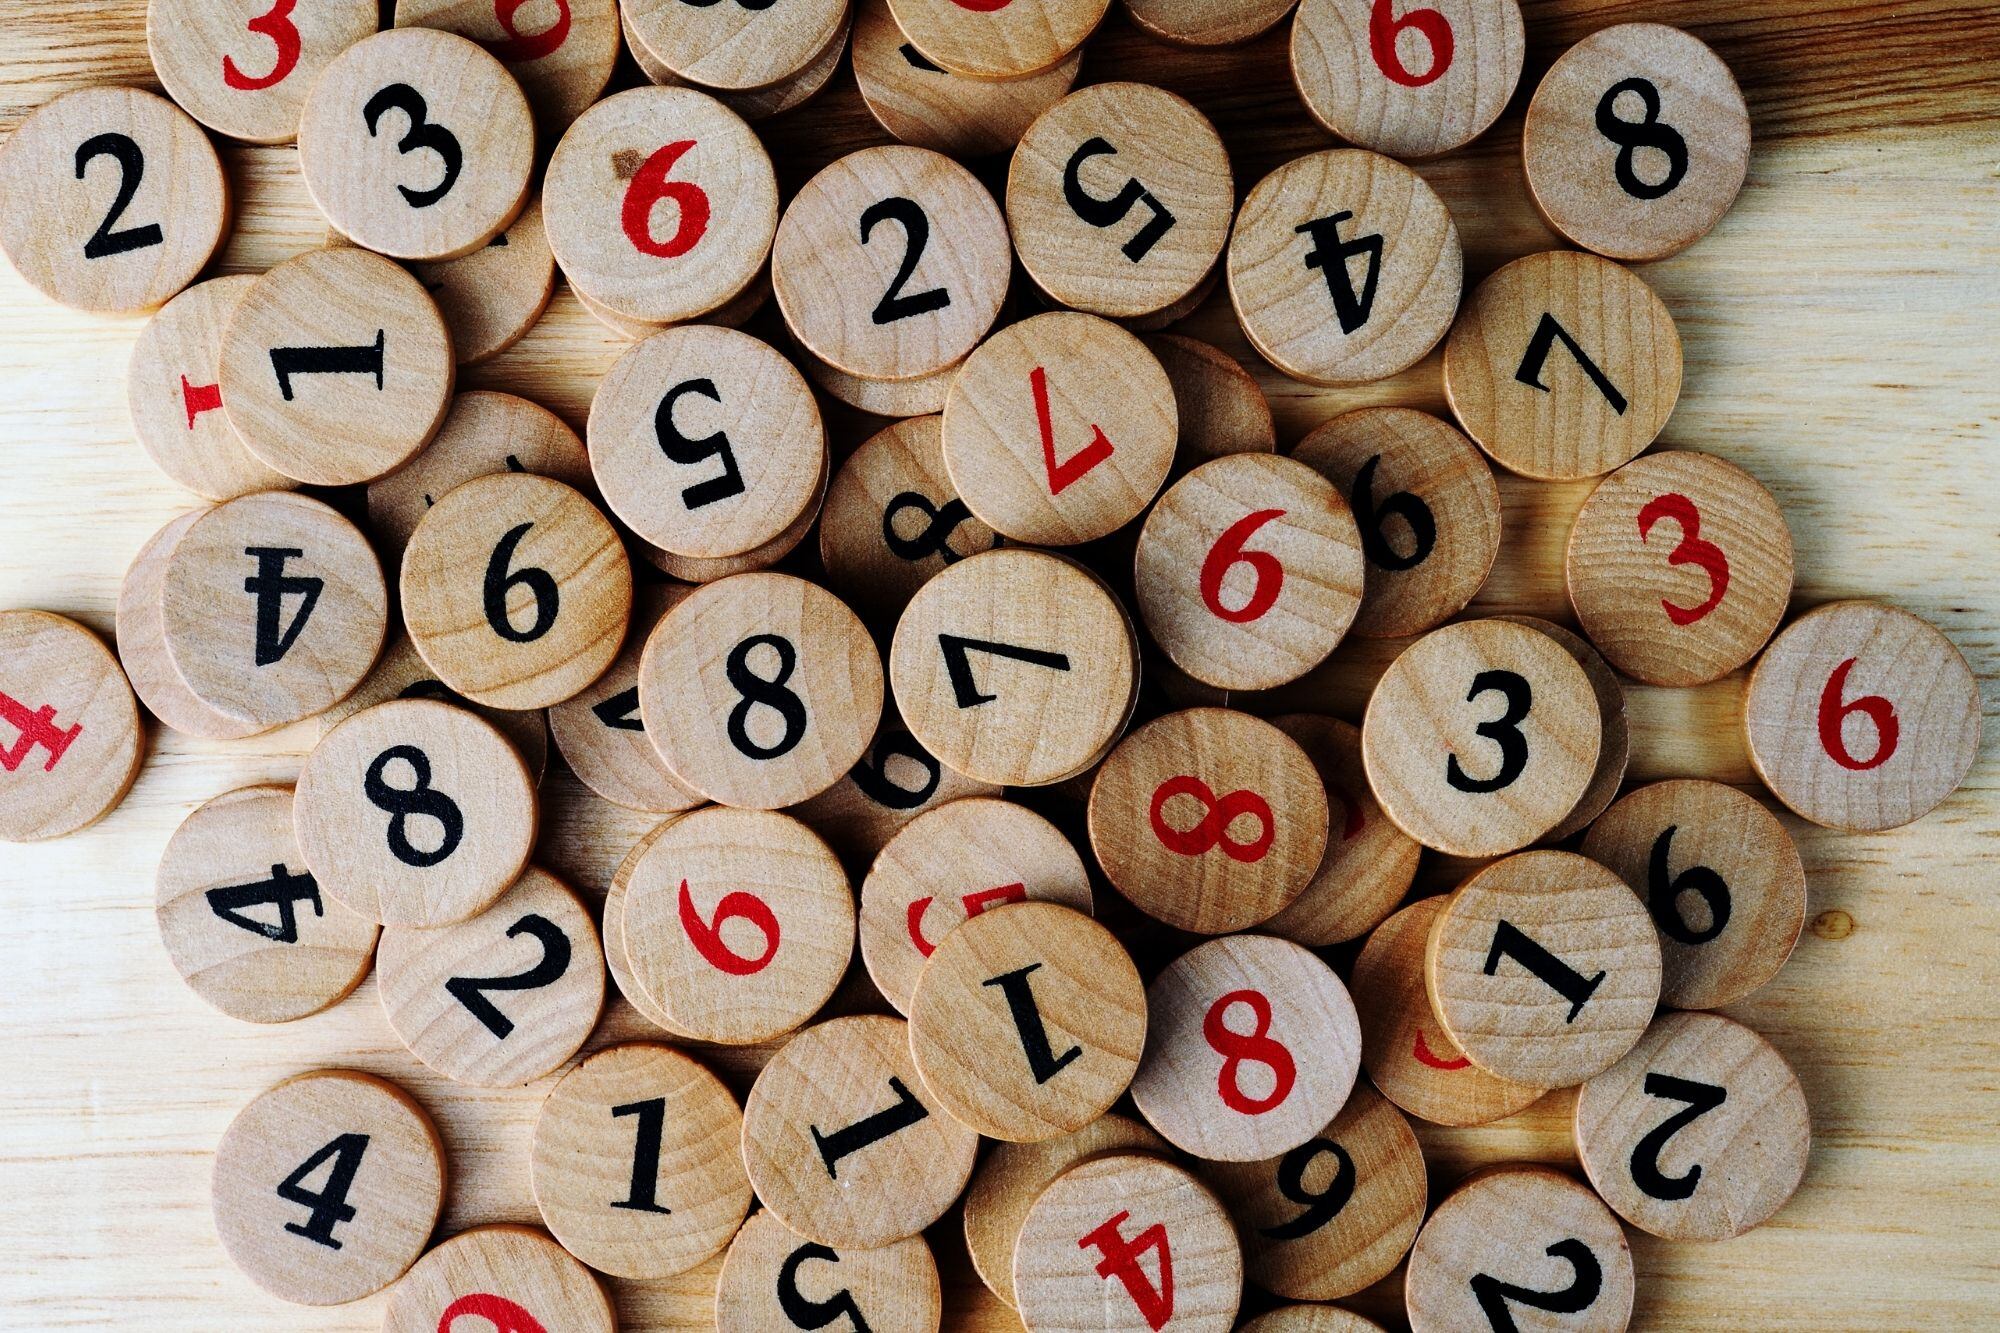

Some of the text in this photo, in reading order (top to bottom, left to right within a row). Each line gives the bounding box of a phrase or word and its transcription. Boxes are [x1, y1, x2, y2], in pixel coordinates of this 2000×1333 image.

[222, 0, 302, 91] 3
[1369, 0, 1454, 87] 6
[76, 133, 163, 259] 2
[363, 83, 462, 208] 3
[621, 139, 711, 259] 6
[1595, 78, 1688, 200] 8
[1064, 137, 1176, 263] 5
[860, 197, 950, 324] 2
[1295, 211, 1383, 335] 4
[270, 329, 384, 401] 1
[1515, 312, 1627, 416] 7
[655, 378, 745, 510] 5
[1029, 366, 1114, 496] 7
[1200, 509, 1286, 624] 6
[1352, 454, 1436, 571] 6
[1637, 492, 1730, 626] 3
[245, 547, 324, 666] 4
[484, 523, 559, 643] 6
[727, 634, 806, 760] 8
[939, 634, 1070, 708] 7
[1817, 660, 1898, 771] 6
[1447, 670, 1532, 793] 3
[364, 745, 463, 867] 8
[1149, 775, 1275, 864] 8
[205, 863, 324, 943] 4
[678, 879, 781, 977] 6
[1649, 825, 1731, 945] 6
[446, 914, 571, 1039] 2
[983, 963, 1082, 1084] 1
[1484, 920, 1606, 1024] 1
[1203, 989, 1297, 1116] 8
[611, 1098, 671, 1214] 1
[811, 1077, 928, 1179] 1
[1630, 1073, 1727, 1201] 2
[278, 1134, 370, 1249] 4
[777, 1242, 872, 1333] 5
[1077, 1210, 1174, 1333] 4
[1470, 1238, 1602, 1333] 2
